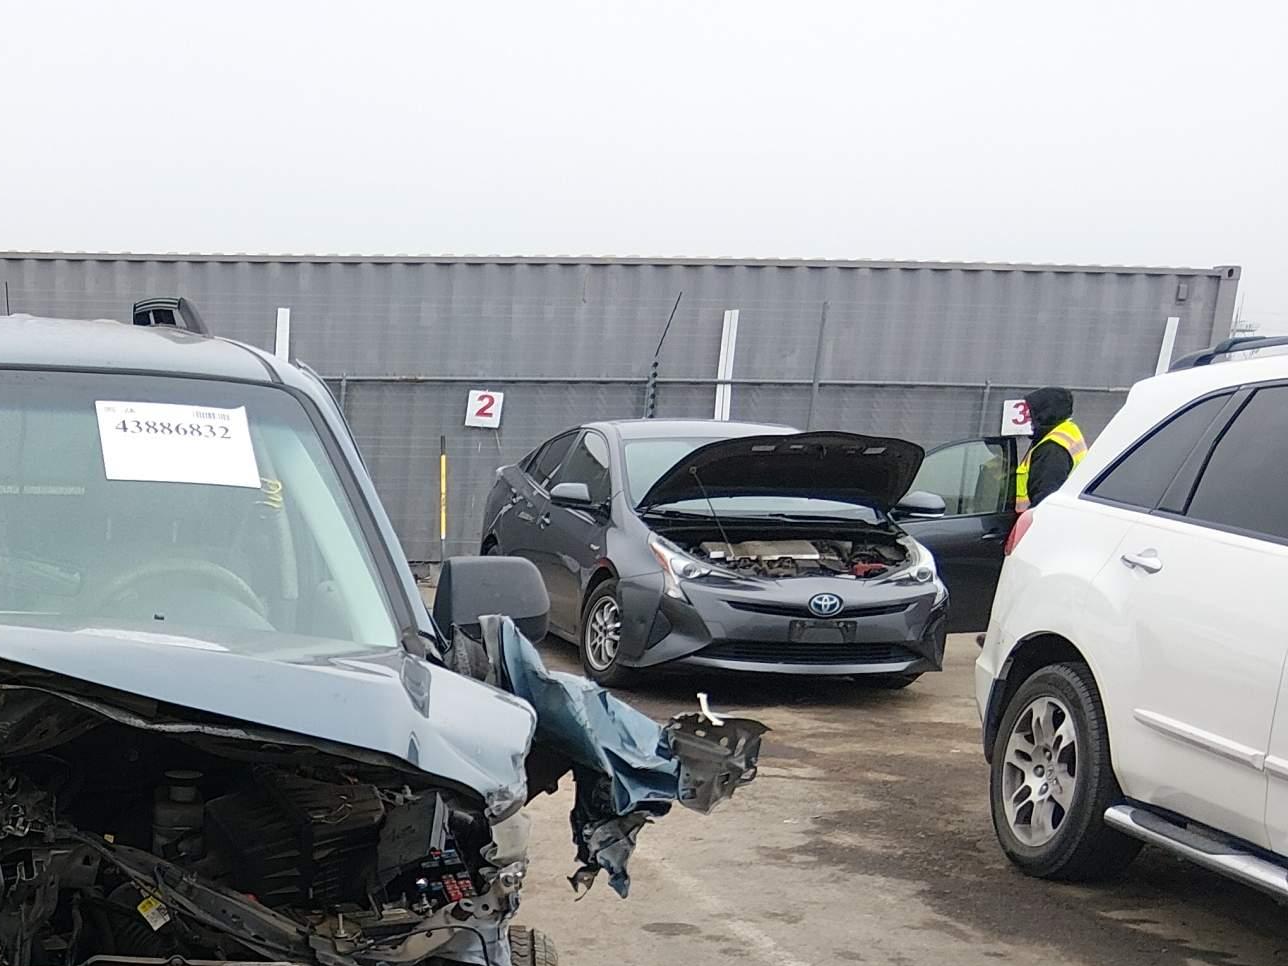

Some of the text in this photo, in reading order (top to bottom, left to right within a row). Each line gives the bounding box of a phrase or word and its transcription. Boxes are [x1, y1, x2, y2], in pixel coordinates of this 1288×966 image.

[475, 395, 495, 418] 2
[1011, 402, 1030, 426] 3
[115, 418, 233, 440] 43886832
